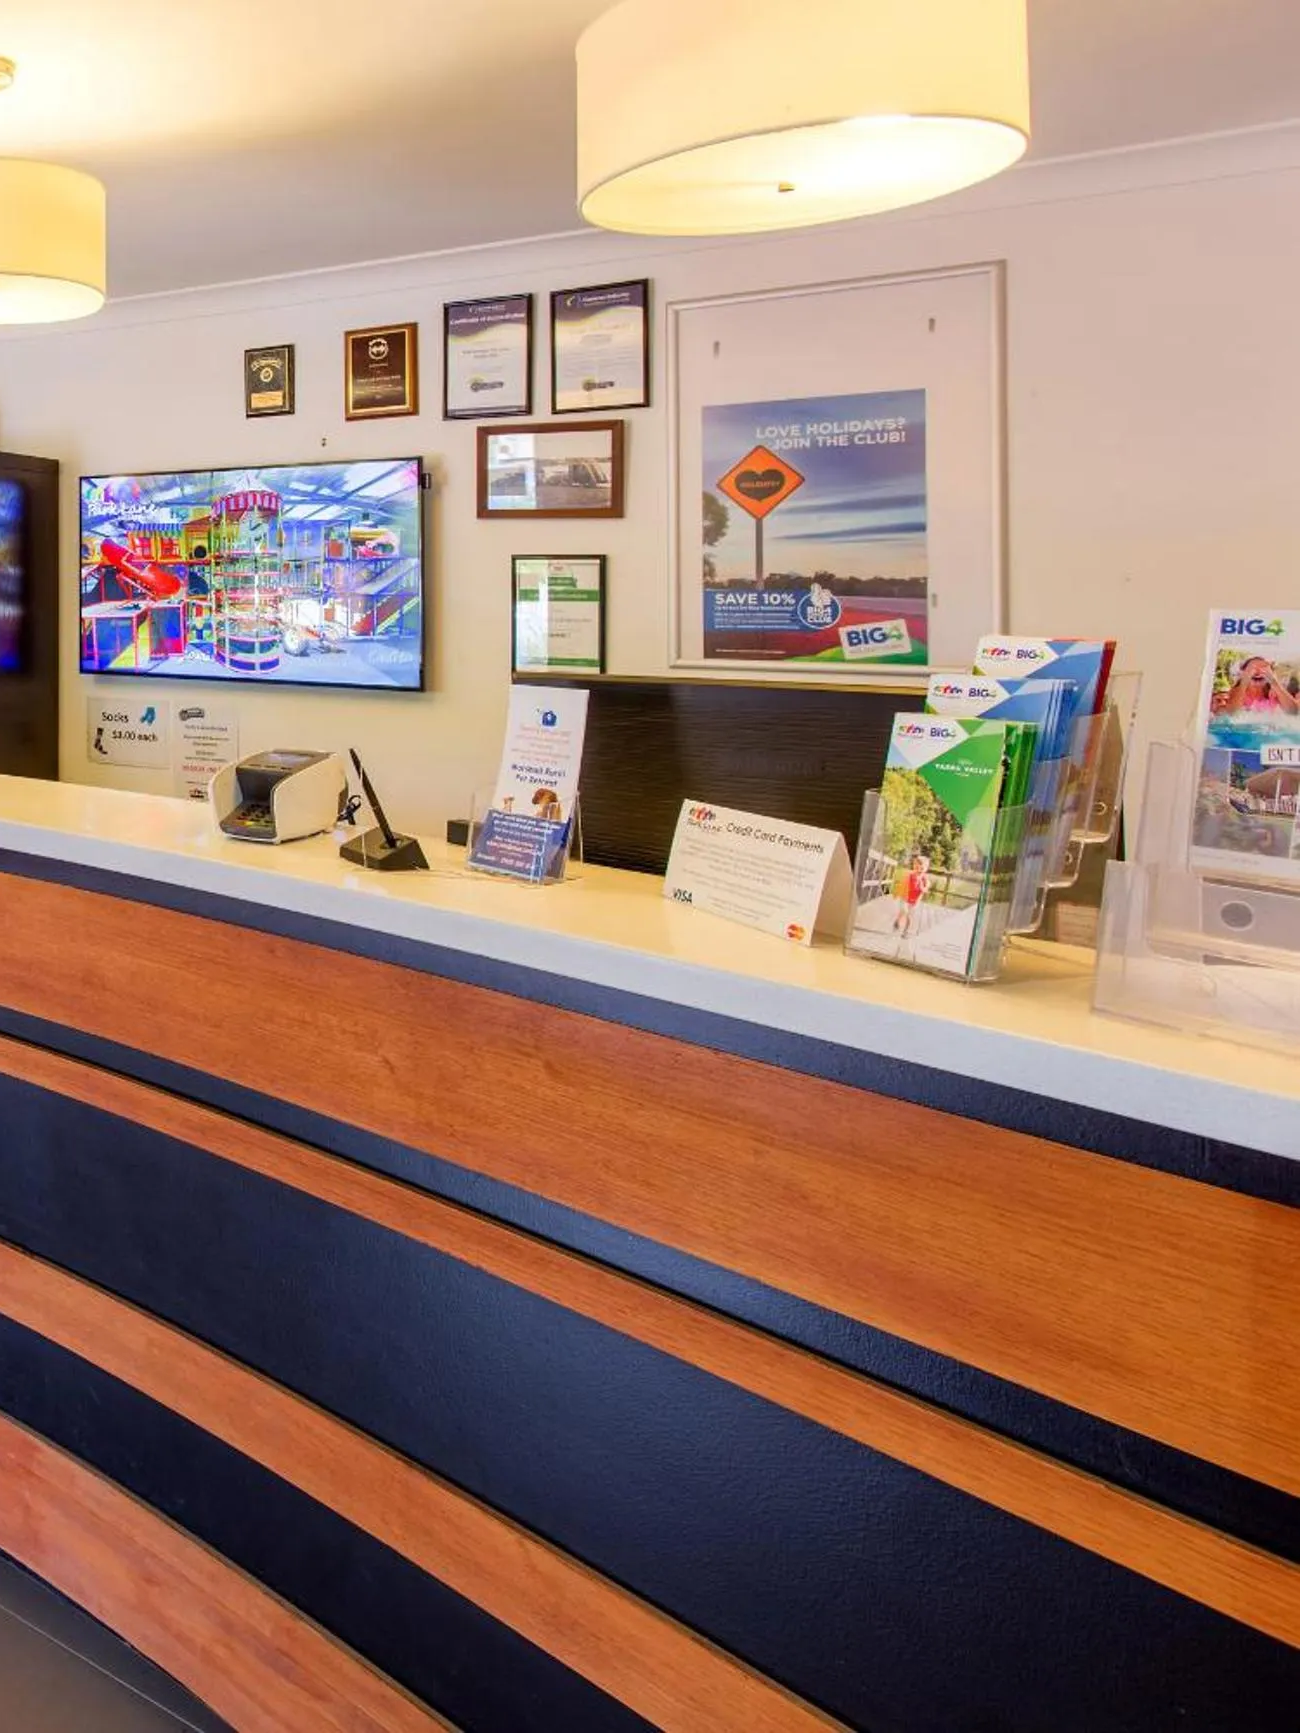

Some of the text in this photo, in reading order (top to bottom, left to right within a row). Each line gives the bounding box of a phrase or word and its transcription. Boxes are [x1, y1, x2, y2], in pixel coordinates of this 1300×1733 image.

[756, 417, 906, 439] LOVE HOLIDAYS?
[774, 431, 906, 450] JOIN THE CLUB!
[715, 592, 796, 605] SAVE 10%
[1219, 617, 1285, 636] BIG4
[846, 625, 904, 647] BIG4
[101, 711, 129, 724] Socks
[136, 731, 158, 742] each
[1268, 747, 1293, 761] ISN'T
[726, 822, 824, 853] Credit Card Payments
[673, 887, 693, 904] VISA
